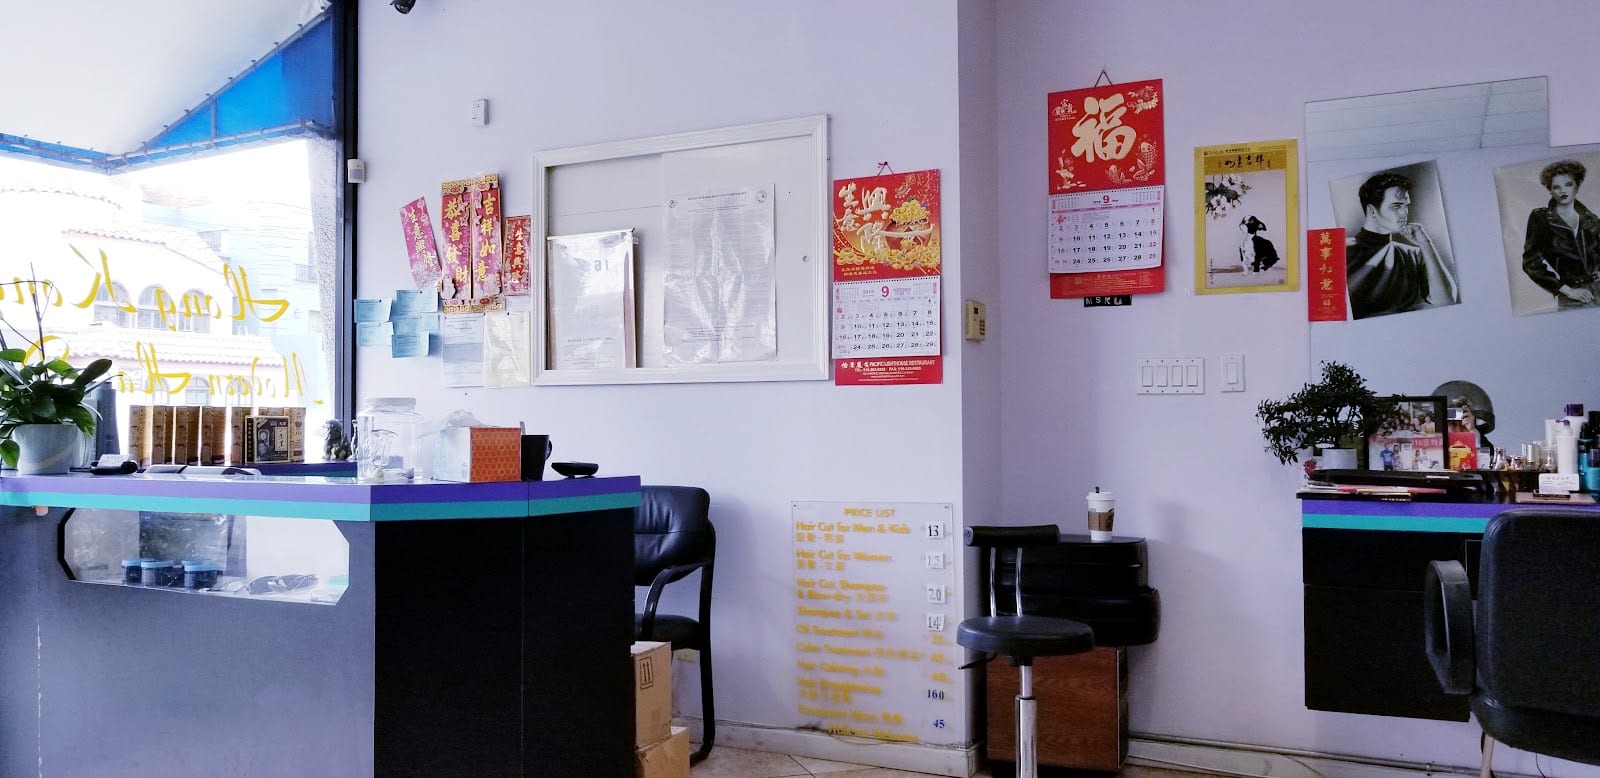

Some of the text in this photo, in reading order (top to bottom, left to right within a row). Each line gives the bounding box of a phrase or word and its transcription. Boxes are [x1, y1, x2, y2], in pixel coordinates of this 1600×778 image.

[1071, 93, 1136, 163] 福
[1103, 195, 1109, 203] 9
[443, 198, 469, 284] 恭喜發財
[476, 193, 496, 282] 吉祥如意
[1319, 232, 1333, 291] 萬事如意
[881, 286, 889, 297] 9
[844, 508, 896, 518] PRICE LIST
[796, 522, 815, 531] Hair
[818, 522, 833, 531] Cut
[837, 523, 850, 532] for
[928, 524, 939, 536] 13
[796, 549, 815, 559] Hair
[818, 550, 834, 559] Cut
[928, 588, 942, 601] 20
[928, 616, 941, 629] 14
[927, 689, 944, 701] 160
[933, 719, 945, 729] 45
